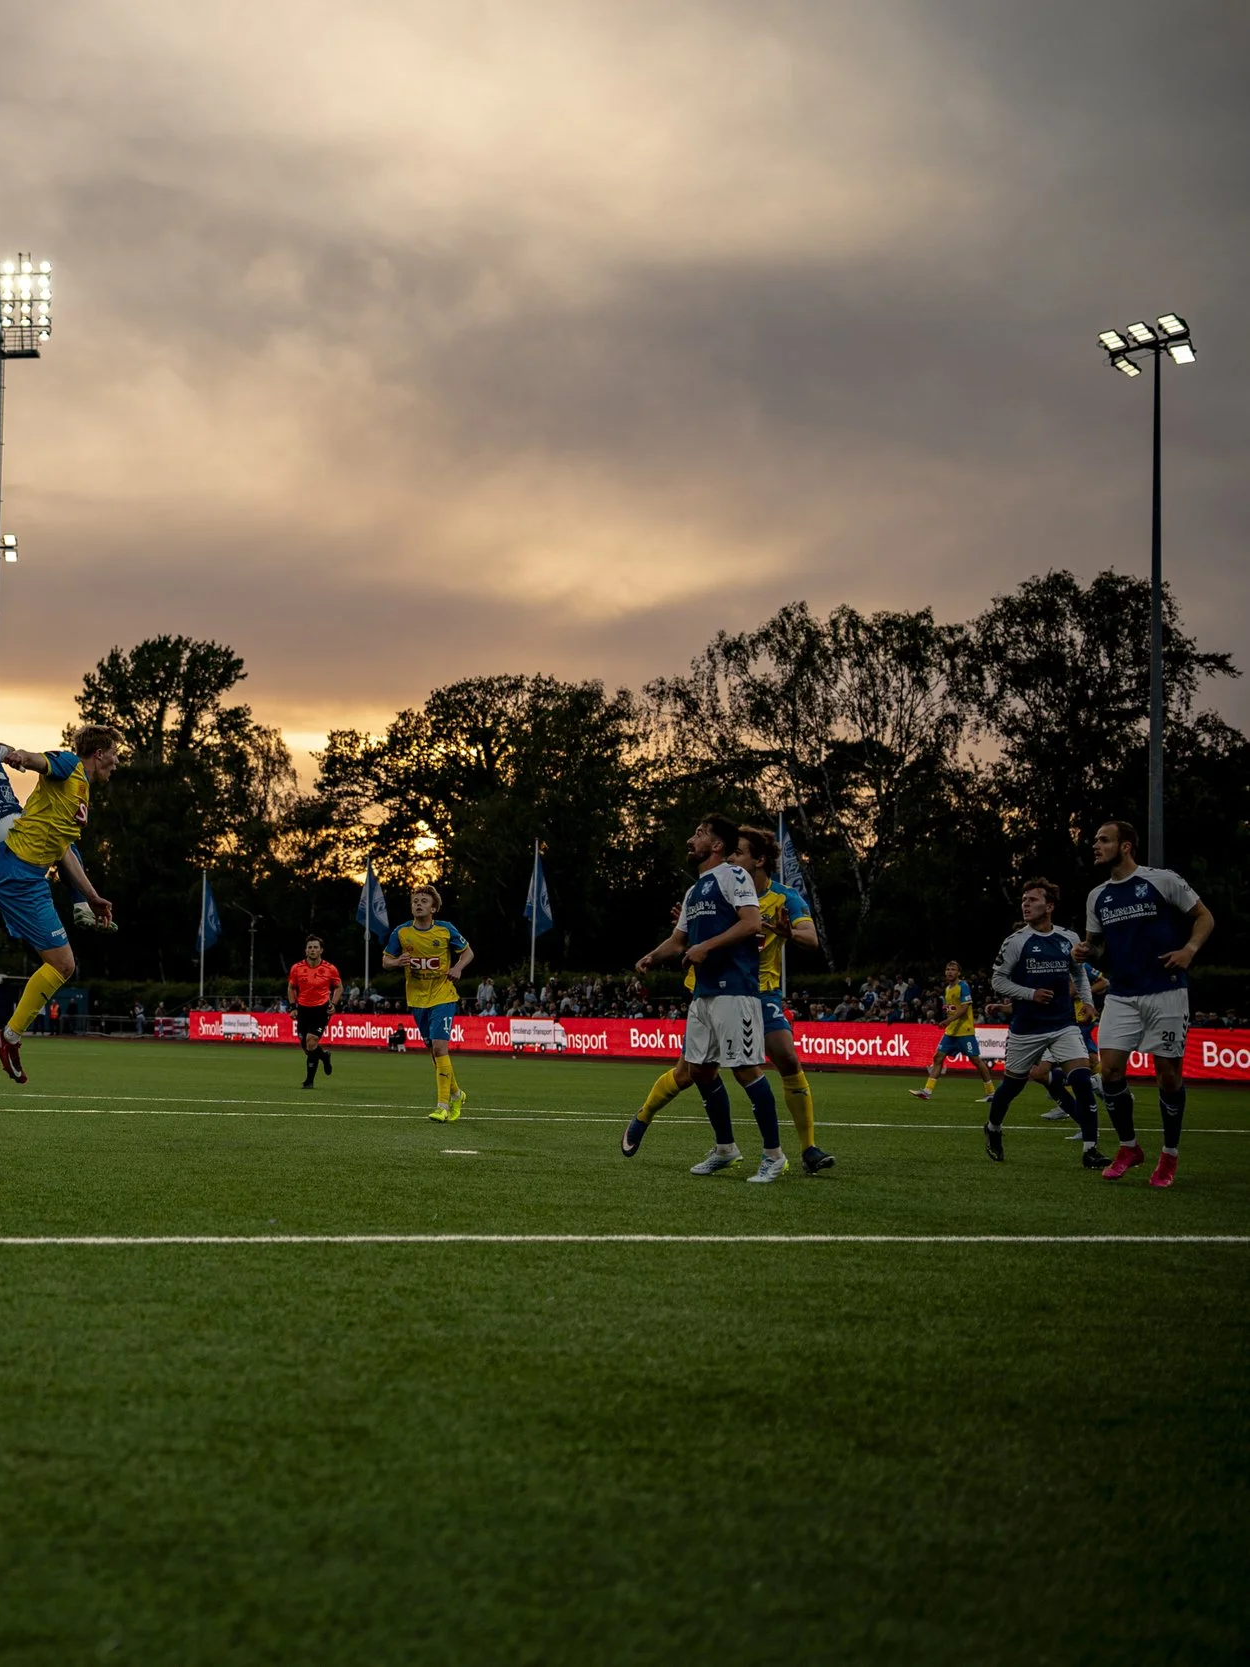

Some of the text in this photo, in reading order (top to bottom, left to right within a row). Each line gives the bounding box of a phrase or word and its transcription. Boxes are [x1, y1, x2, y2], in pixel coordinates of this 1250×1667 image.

[410, 957, 439, 970] SIC
[443, 1017, 452, 1031] 17
[330, 1020, 344, 1042] på
[1161, 1031, 1176, 1042] 20
[629, 1028, 665, 1049] Book
[726, 1039, 732, 1050] 7
[966, 1041, 973, 1051] 8
